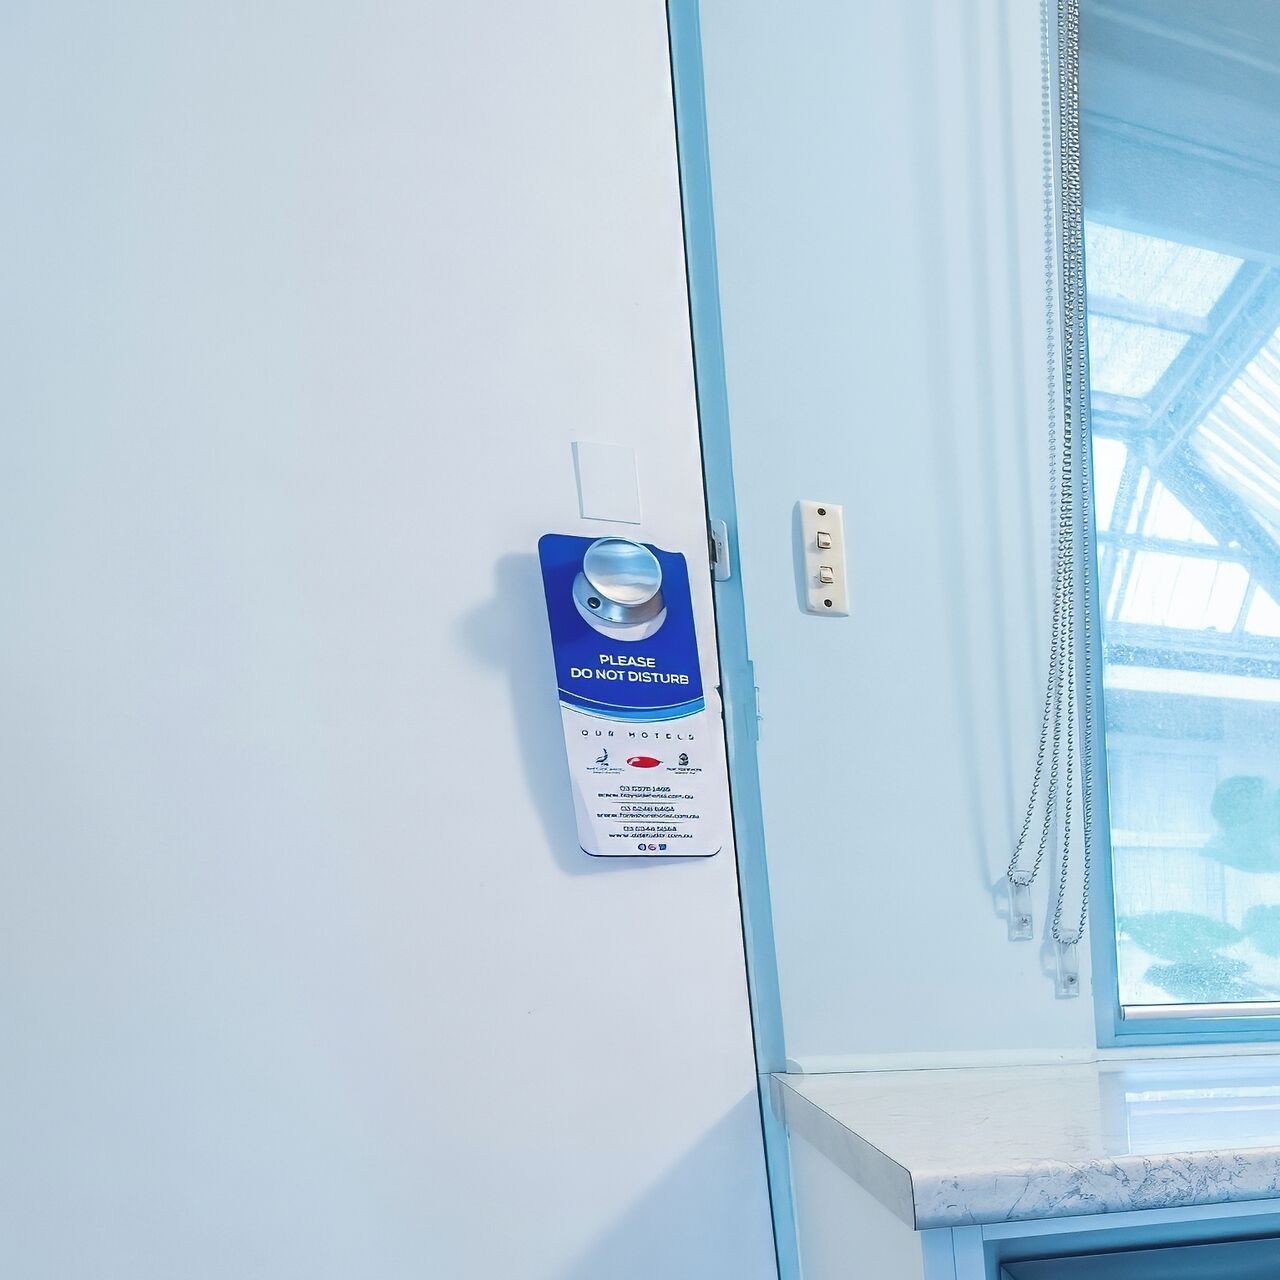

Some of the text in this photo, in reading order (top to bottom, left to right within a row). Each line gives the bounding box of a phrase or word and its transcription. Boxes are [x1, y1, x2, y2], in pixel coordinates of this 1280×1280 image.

[599, 654, 656, 668] PLEASE
[570, 667, 689, 685] DO NOT DISTURB
[581, 729, 695, 741] OUR HOTELS
